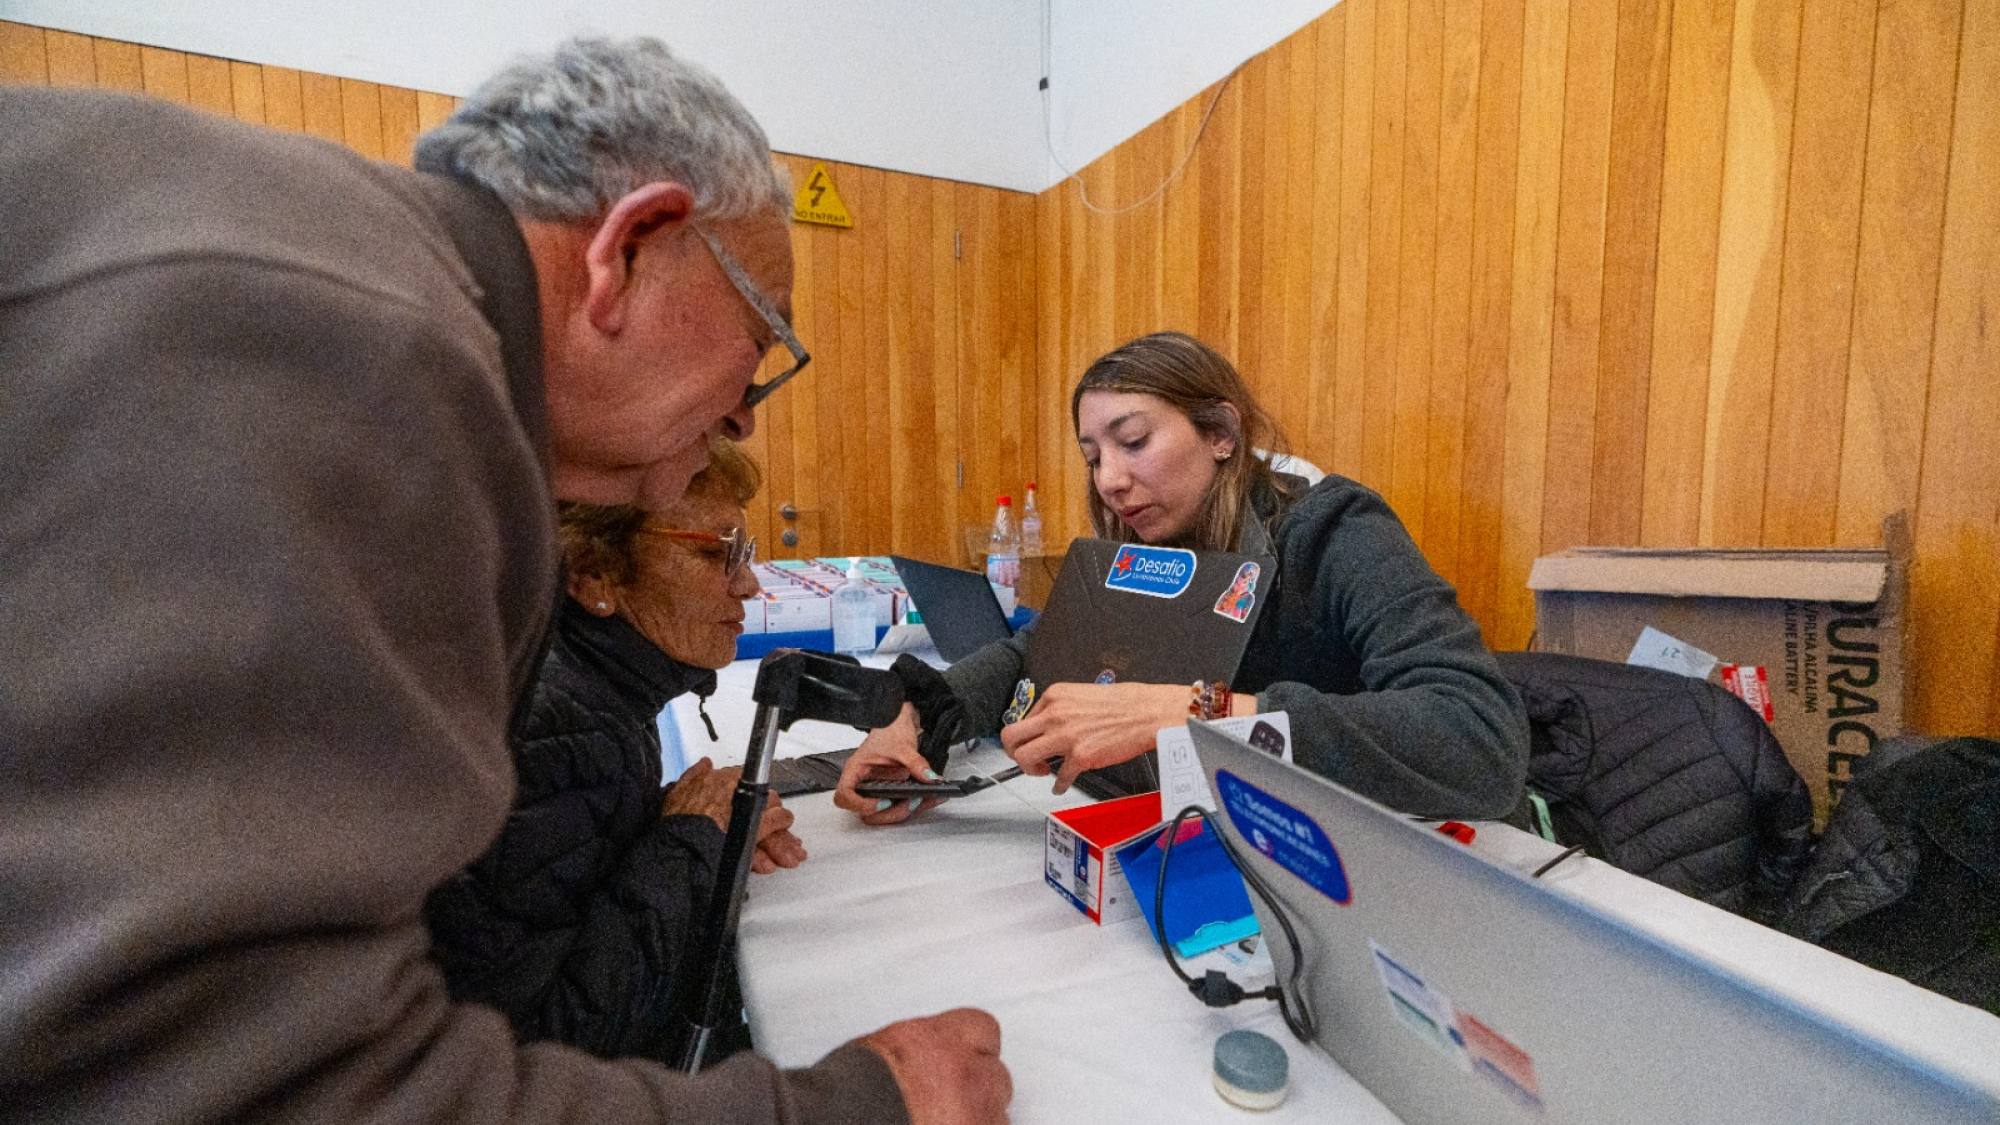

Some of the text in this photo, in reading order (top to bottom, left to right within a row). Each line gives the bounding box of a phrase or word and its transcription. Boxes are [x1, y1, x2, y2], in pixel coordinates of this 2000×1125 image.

[810, 211, 846, 223] ENTRAR
[1785, 601, 1799, 696] ALINE BATTERY
[1744, 674, 1761, 711] RAGILE
[1804, 653, 1818, 714] ALCALINA
[1827, 601, 1880, 806] URACE
